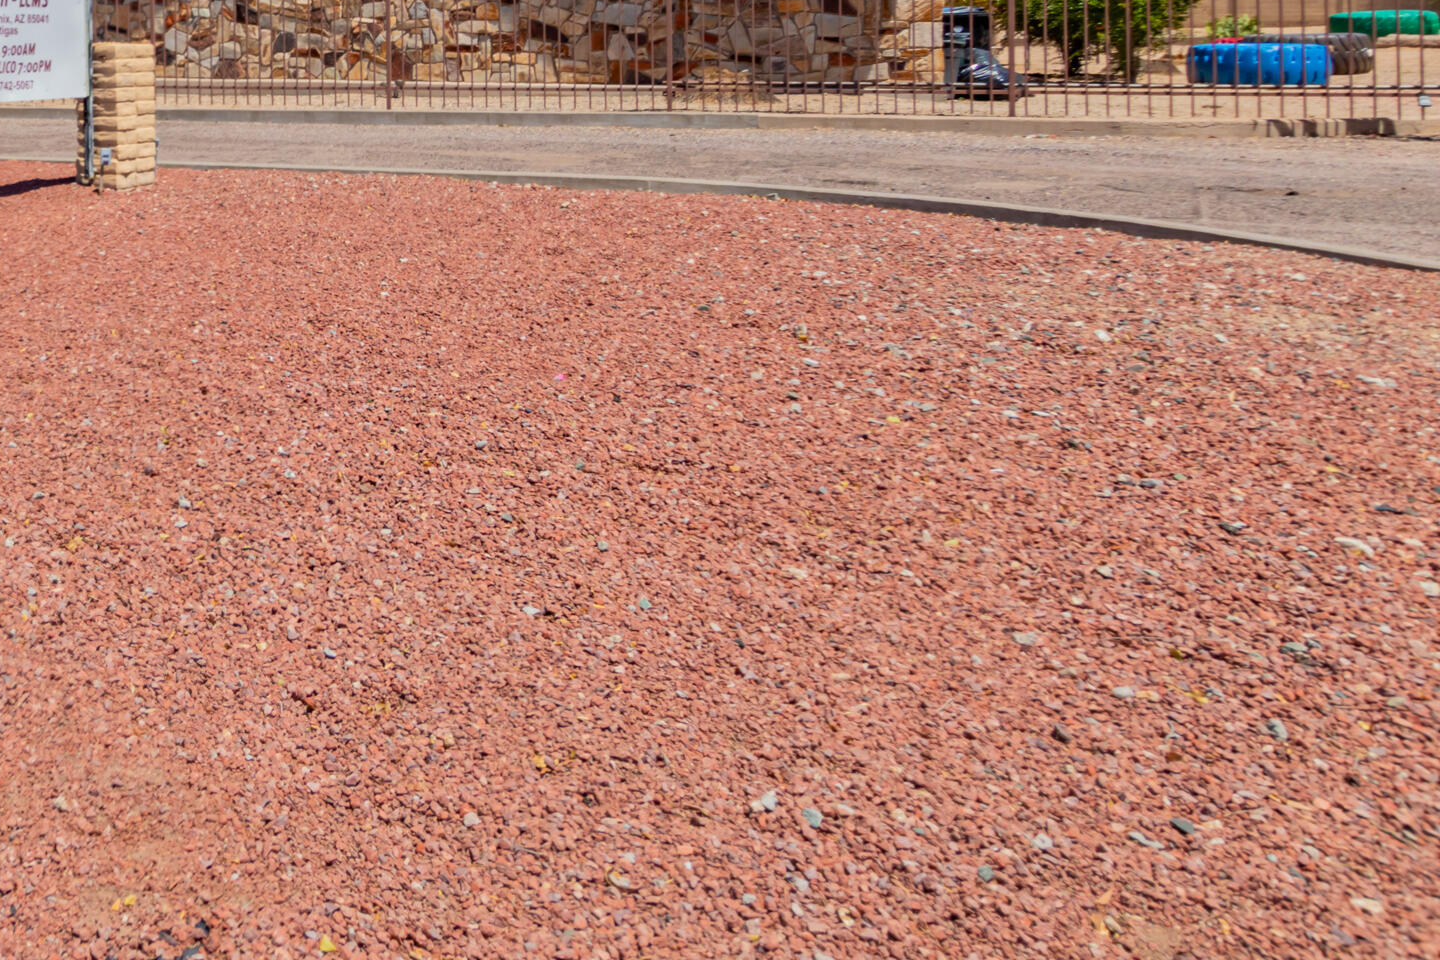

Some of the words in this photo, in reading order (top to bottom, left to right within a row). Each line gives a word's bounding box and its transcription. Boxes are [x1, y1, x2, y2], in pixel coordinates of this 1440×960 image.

[14, 14, 26, 23] AZ
[27, 15, 49, 24] 85041
[1, 43, 36, 58] 9:00AM
[17, 60, 52, 75] 7:00PM
